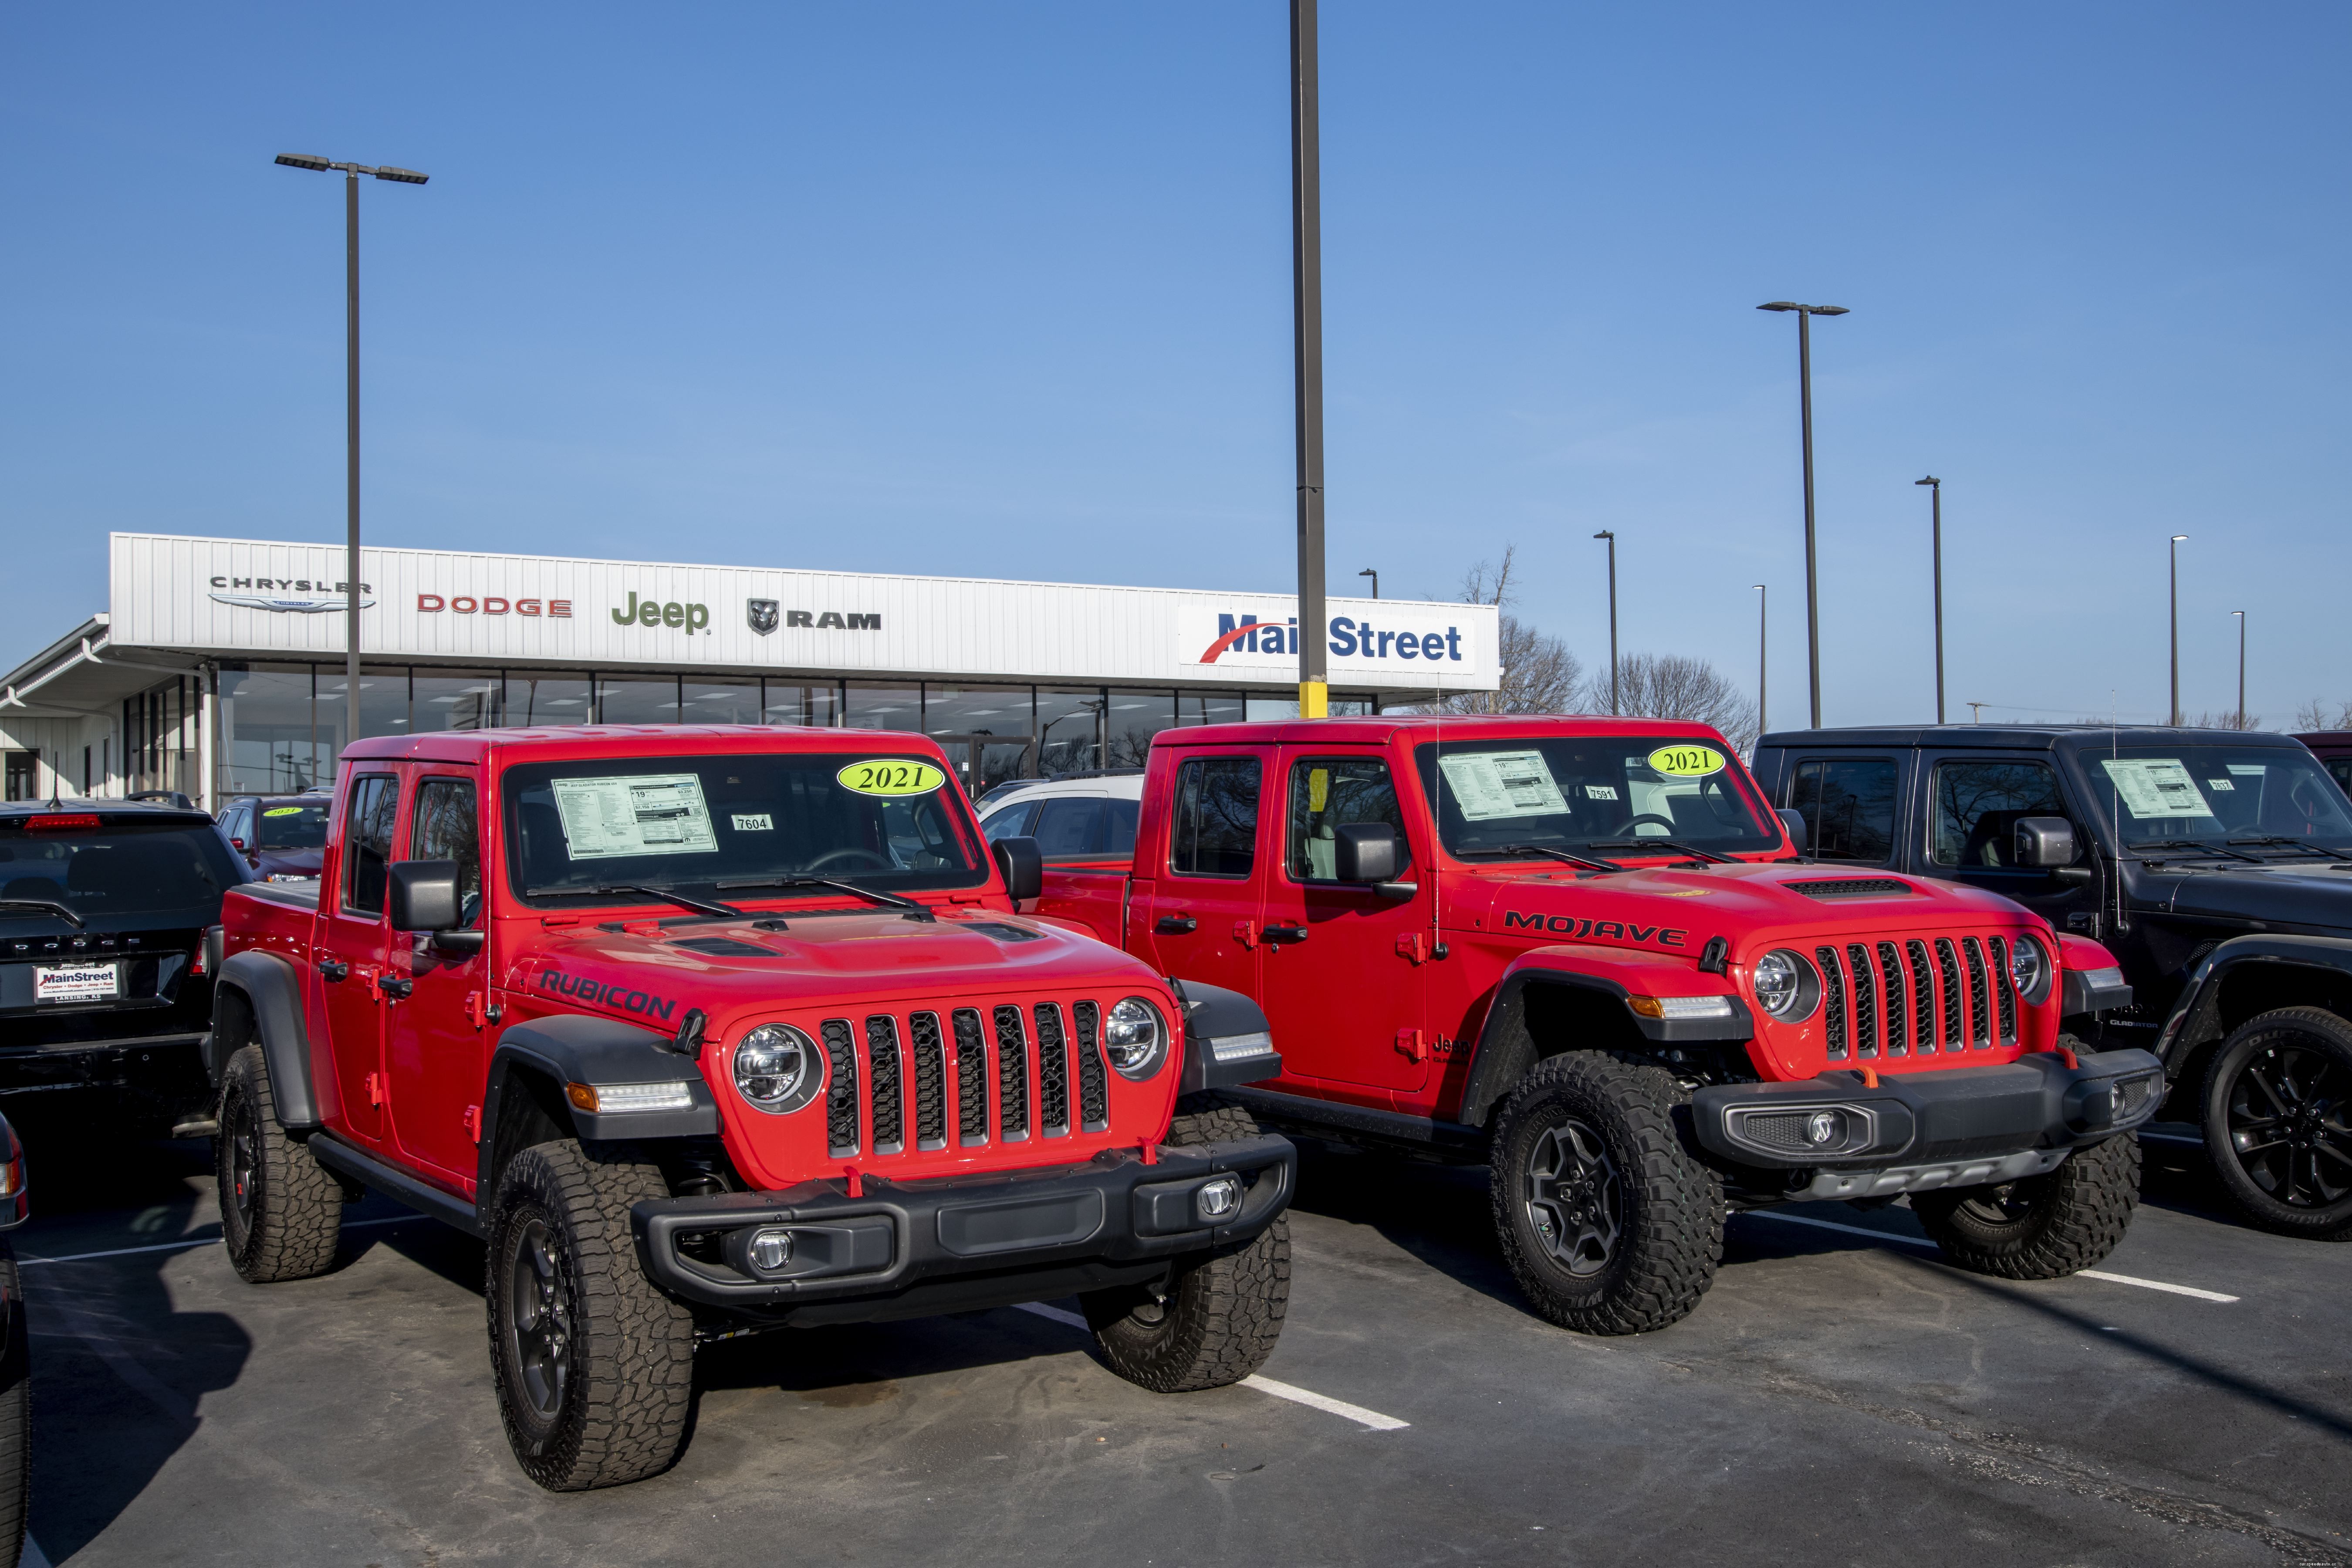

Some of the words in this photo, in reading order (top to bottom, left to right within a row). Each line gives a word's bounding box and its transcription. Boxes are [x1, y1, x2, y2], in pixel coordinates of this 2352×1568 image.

[210, 576, 372, 594] CHRYSLER
[418, 593, 573, 618] DODGE
[612, 591, 709, 635] Jeep
[787, 610, 882, 630] RAM
[1218, 613, 1461, 661] MaiStreet
[1664, 751, 1711, 770] 2021
[858, 767, 923, 788] 2021
[1591, 790, 1612, 799] 7591
[738, 819, 767, 829] 7604
[1504, 910, 1689, 948] MOJAVE
[43, 972, 113, 983] MainStreet
[540, 969, 677, 1020] RUBICON
[2110, 1019, 2159, 1028] GLADIATOR
[1433, 1033, 1470, 1058] Jeep
